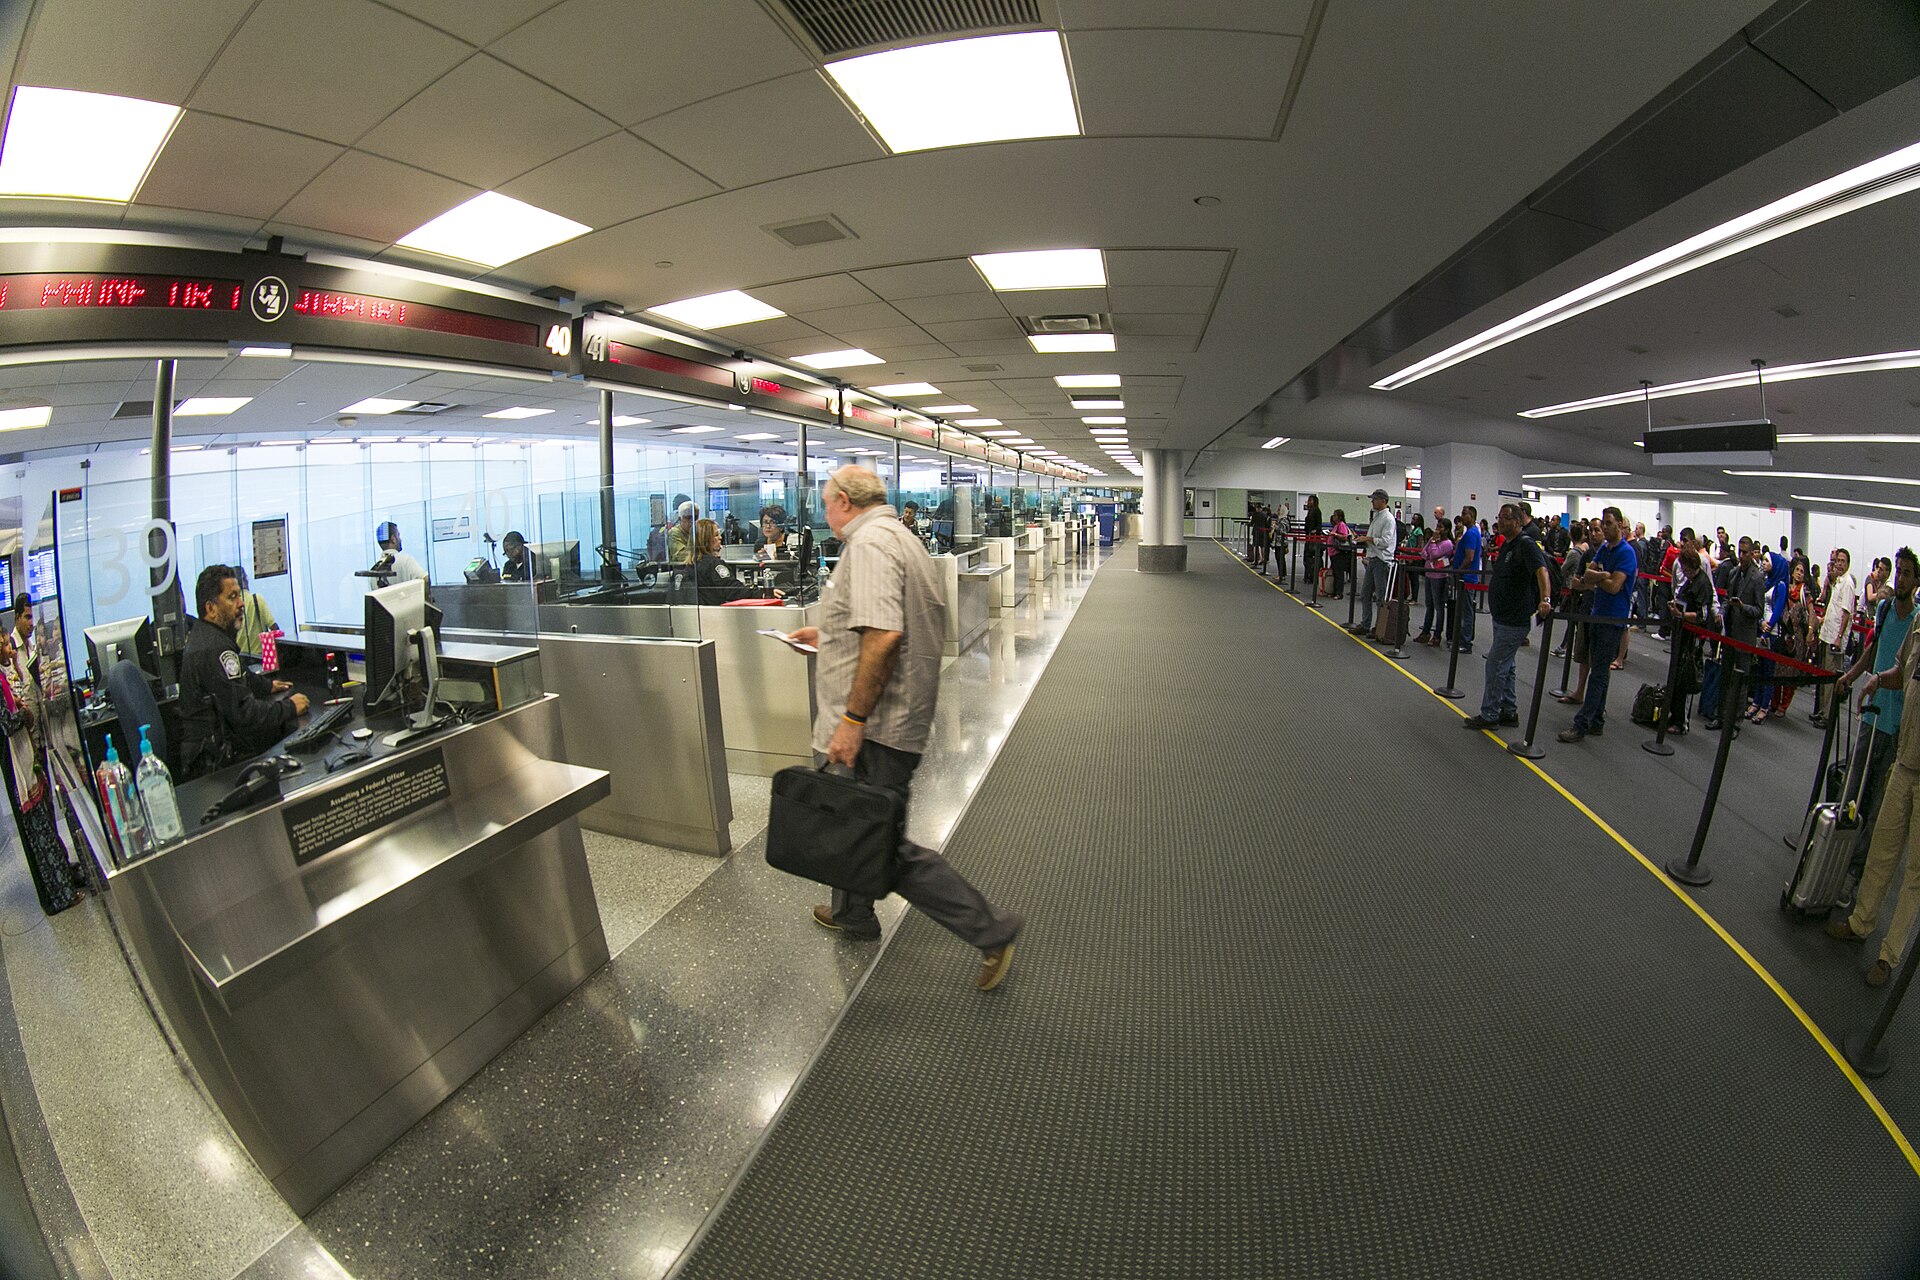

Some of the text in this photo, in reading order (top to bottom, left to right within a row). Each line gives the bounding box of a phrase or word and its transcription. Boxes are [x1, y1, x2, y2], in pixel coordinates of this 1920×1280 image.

[546, 324, 571, 357] 40
[587, 334, 605, 362] 41
[453, 489, 510, 543] 40
[94, 518, 177, 606] 39
[331, 791, 359, 806] Assaulting
[366, 778, 385, 791] Federal
[387, 771, 404, 782] Officer
